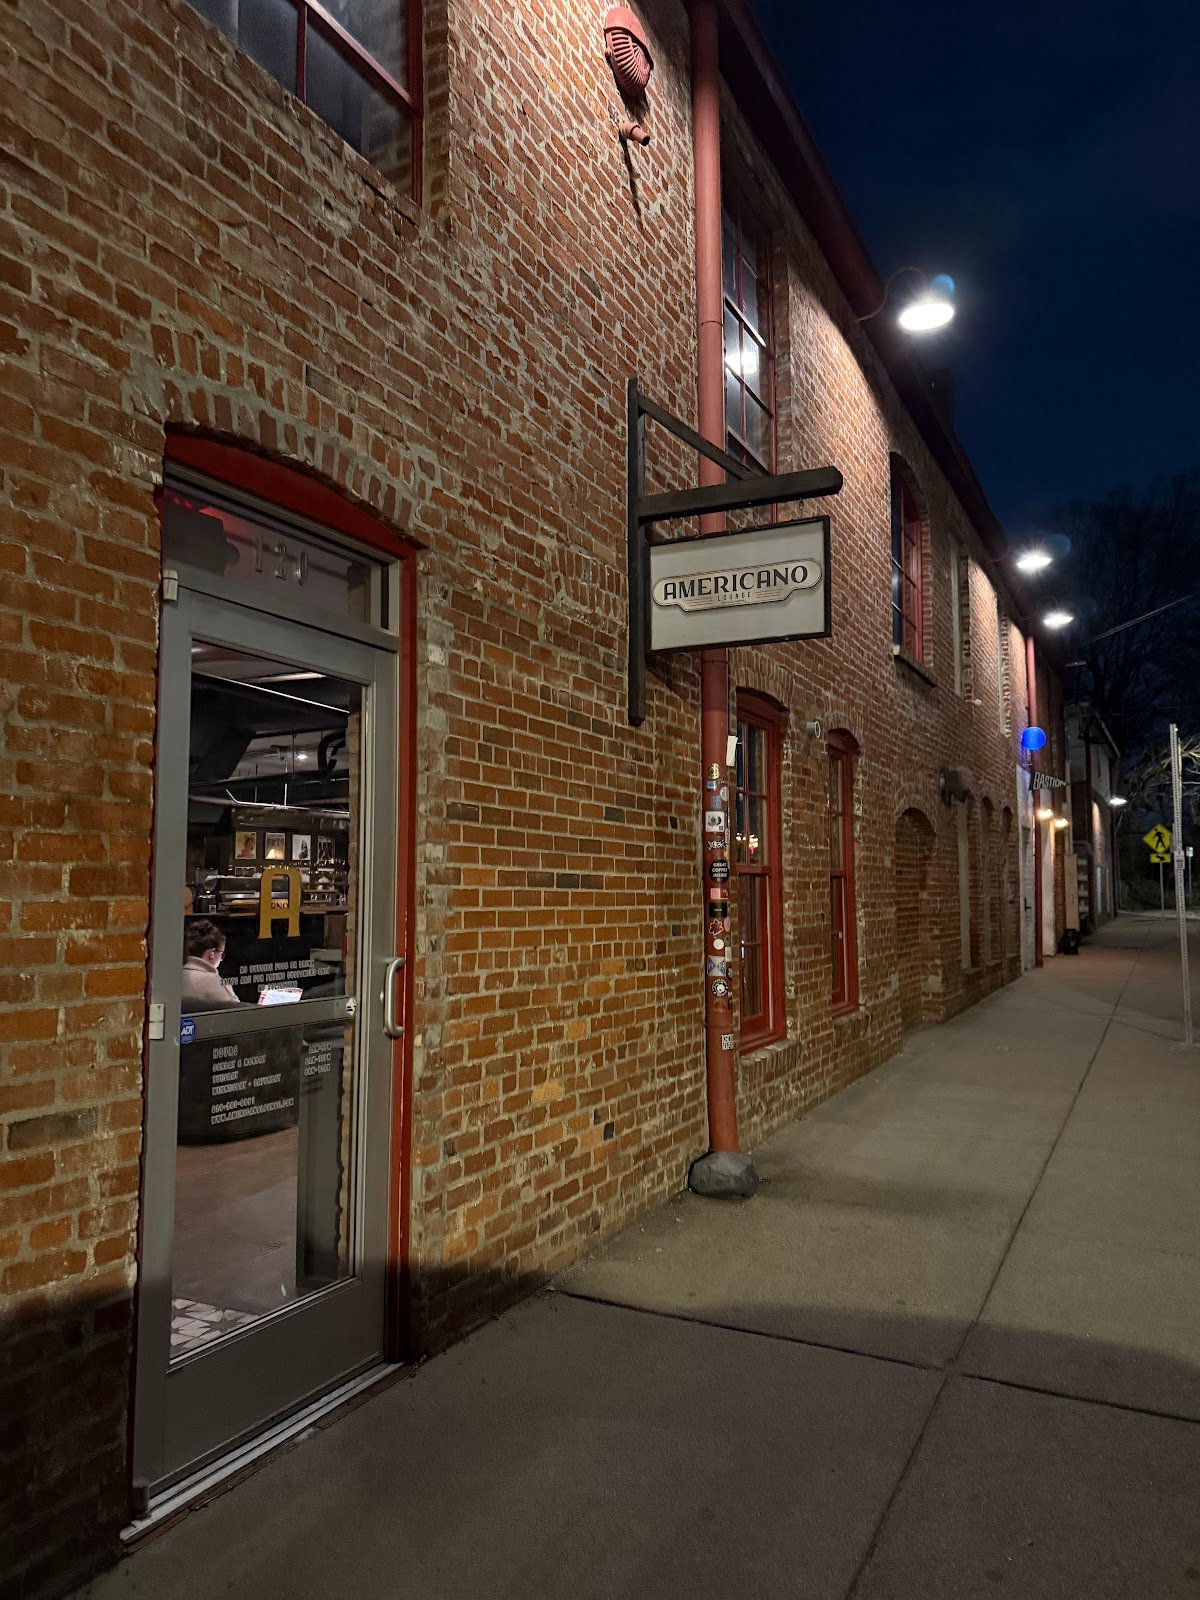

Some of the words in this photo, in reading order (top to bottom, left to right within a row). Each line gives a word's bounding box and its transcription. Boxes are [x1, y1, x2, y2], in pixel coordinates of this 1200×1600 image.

[664, 565, 808, 600] AMERICANO
[1033, 771, 1066, 790] BASTION
[181, 1025, 194, 1036] ADT
